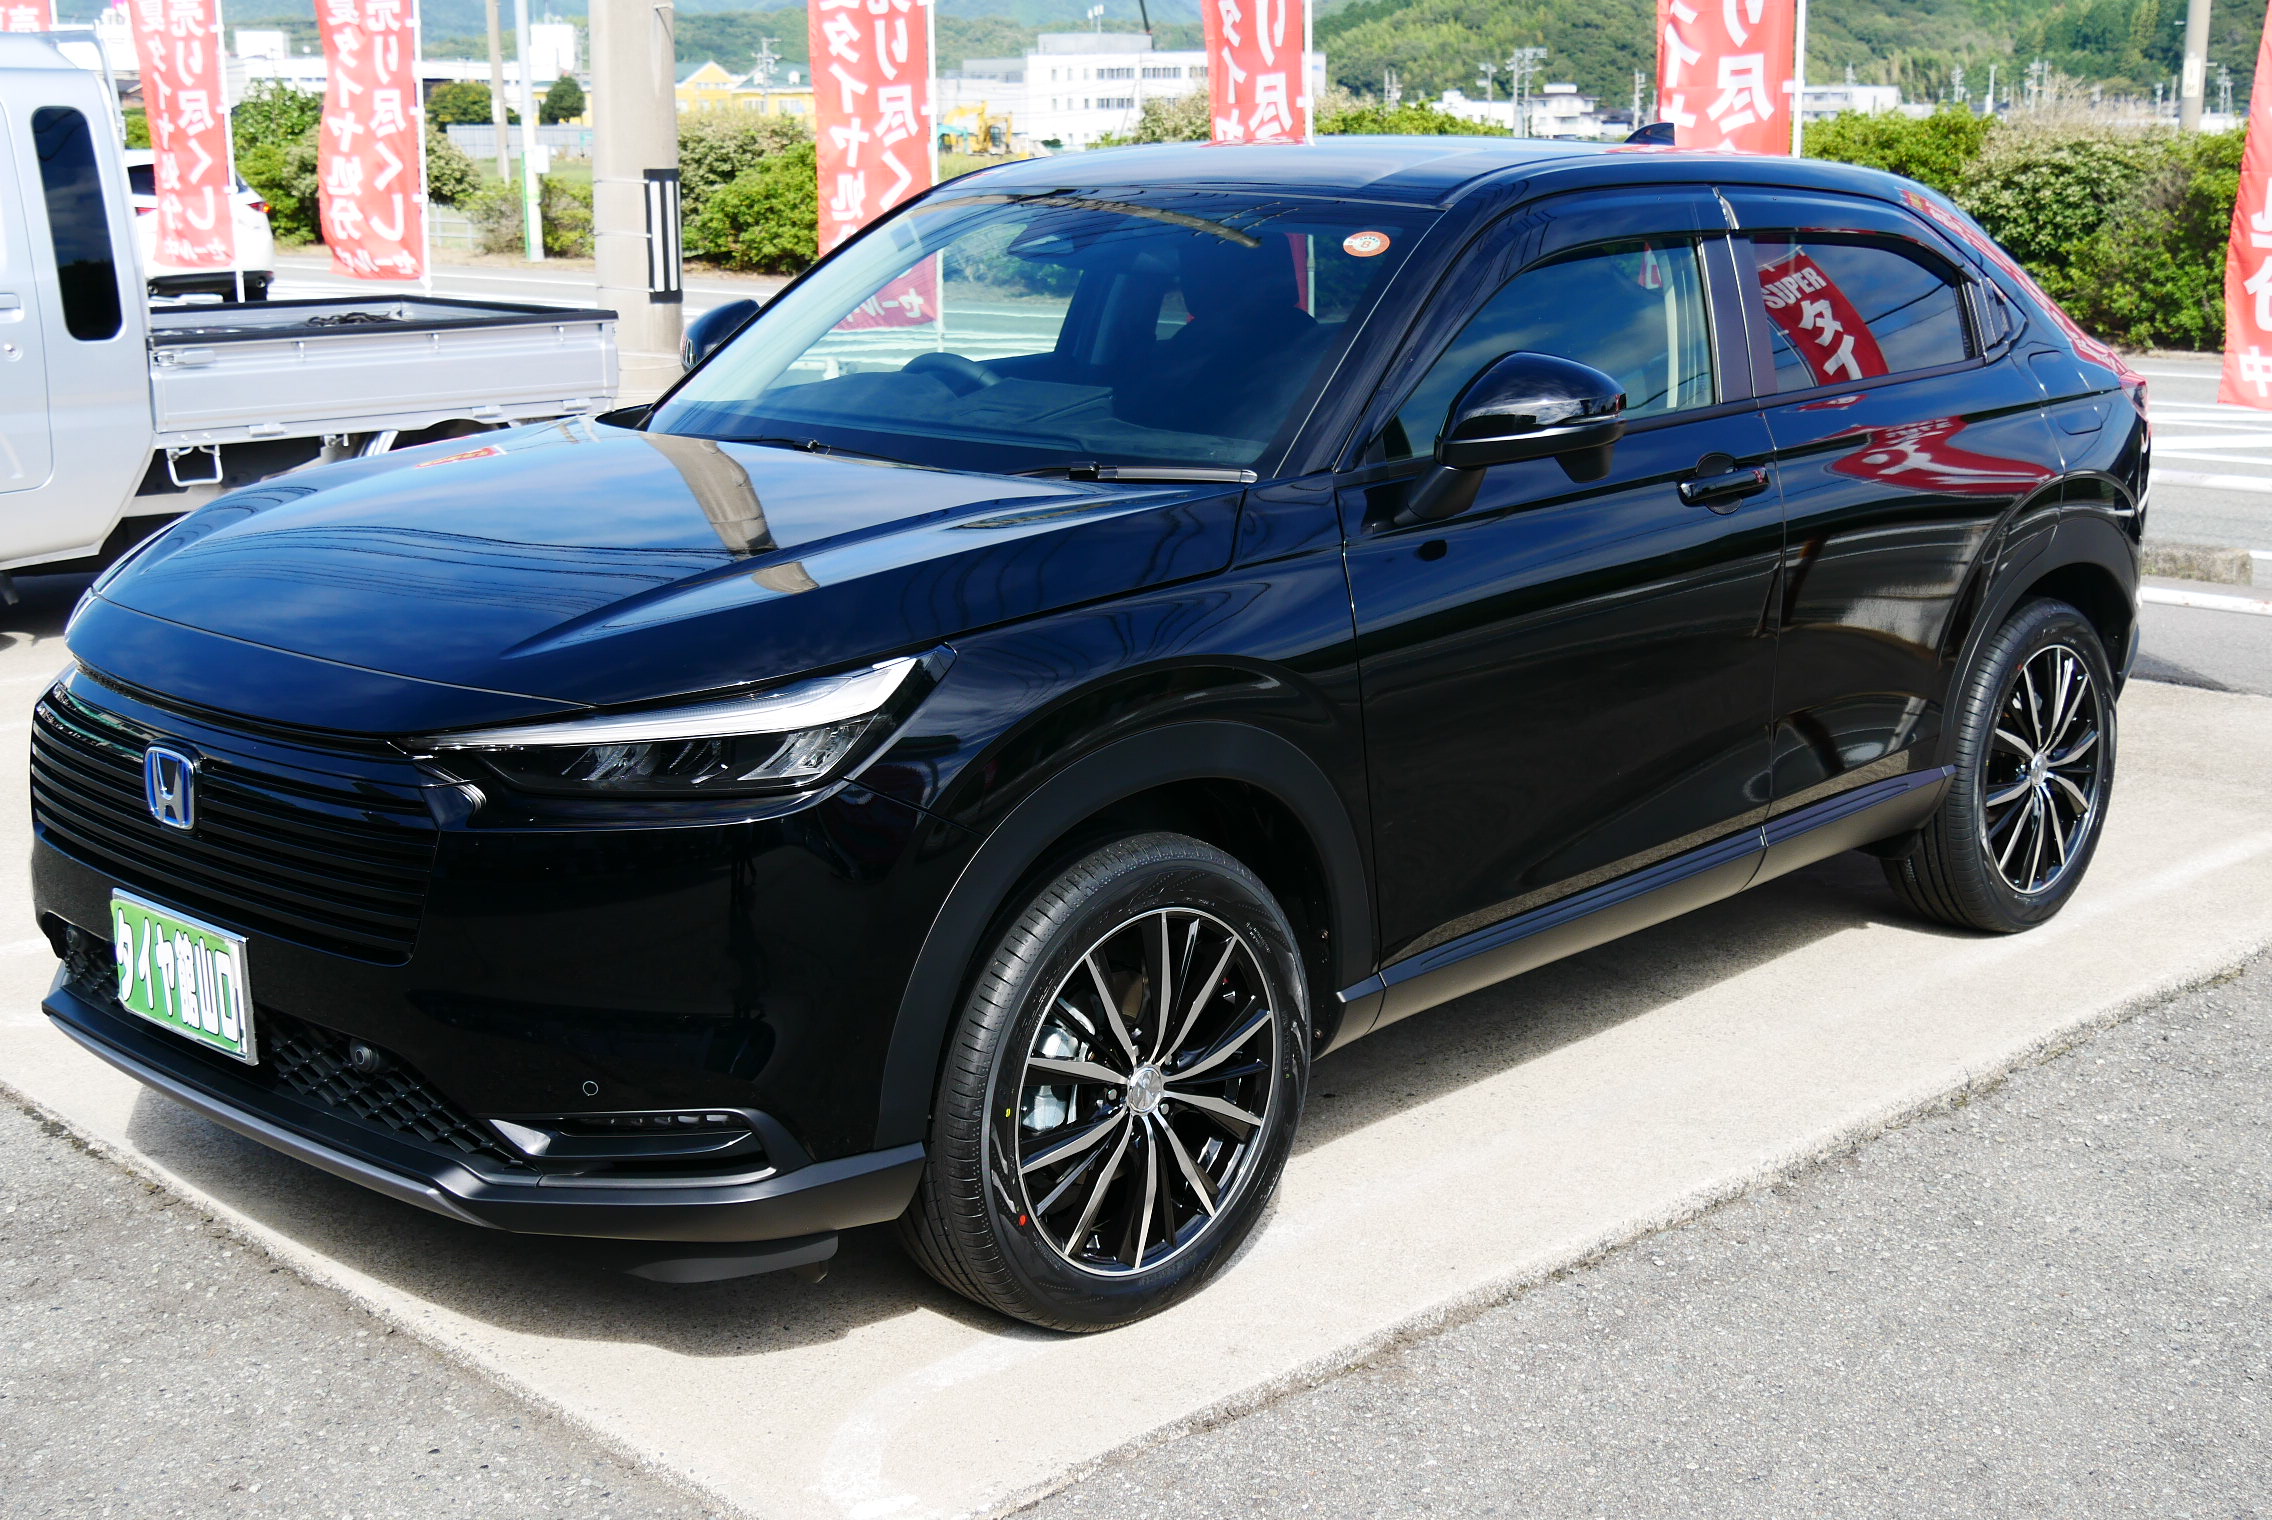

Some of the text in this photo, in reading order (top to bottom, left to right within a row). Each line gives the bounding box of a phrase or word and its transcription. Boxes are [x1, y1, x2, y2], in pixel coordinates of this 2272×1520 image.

[1761, 267, 1828, 309] SUPER
[116, 907, 239, 1043] タイヤ館山口
